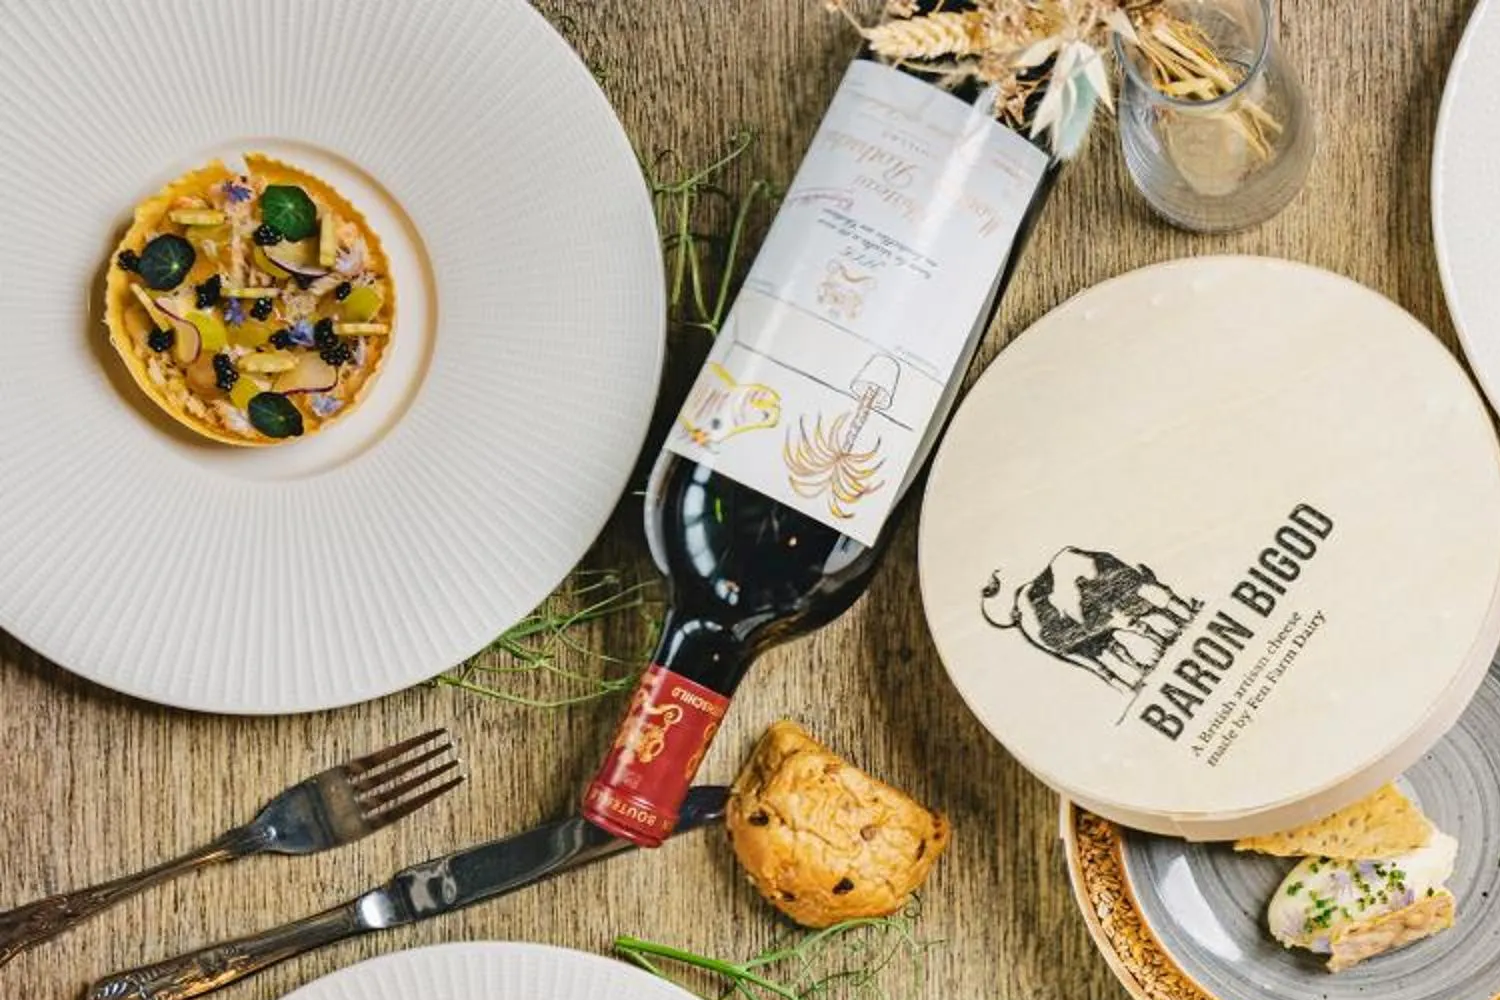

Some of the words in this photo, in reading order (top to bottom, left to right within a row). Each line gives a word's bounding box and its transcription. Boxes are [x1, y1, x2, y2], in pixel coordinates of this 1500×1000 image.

[1140, 611, 1255, 742] BARON
[1231, 503, 1334, 618] BIGOD
[1191, 744, 1205, 757] A
[1198, 701, 1236, 743] British
[1234, 656, 1269, 700] artisan
[1266, 611, 1302, 655] cheese
[1207, 729, 1239, 768] made
[1232, 709, 1254, 730] by
[1247, 685, 1271, 710] Fen
[1265, 649, 1298, 684] Farm
[1292, 610, 1327, 649] Dairy
